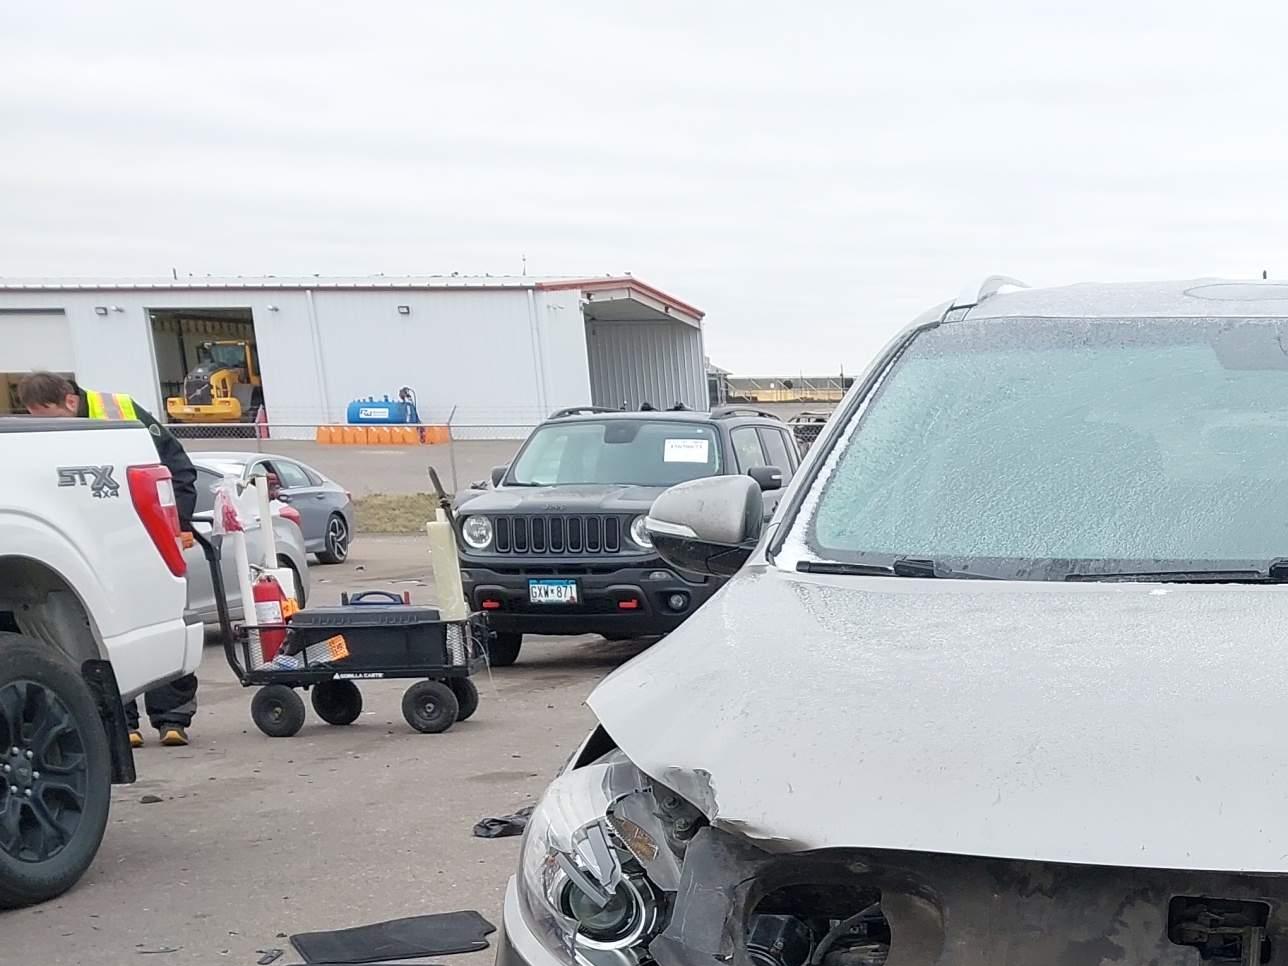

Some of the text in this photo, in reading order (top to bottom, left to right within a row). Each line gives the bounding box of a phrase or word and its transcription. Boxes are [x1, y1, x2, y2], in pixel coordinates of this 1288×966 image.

[56, 465, 120, 491] STX
[531, 586, 573, 598] GXW 871
